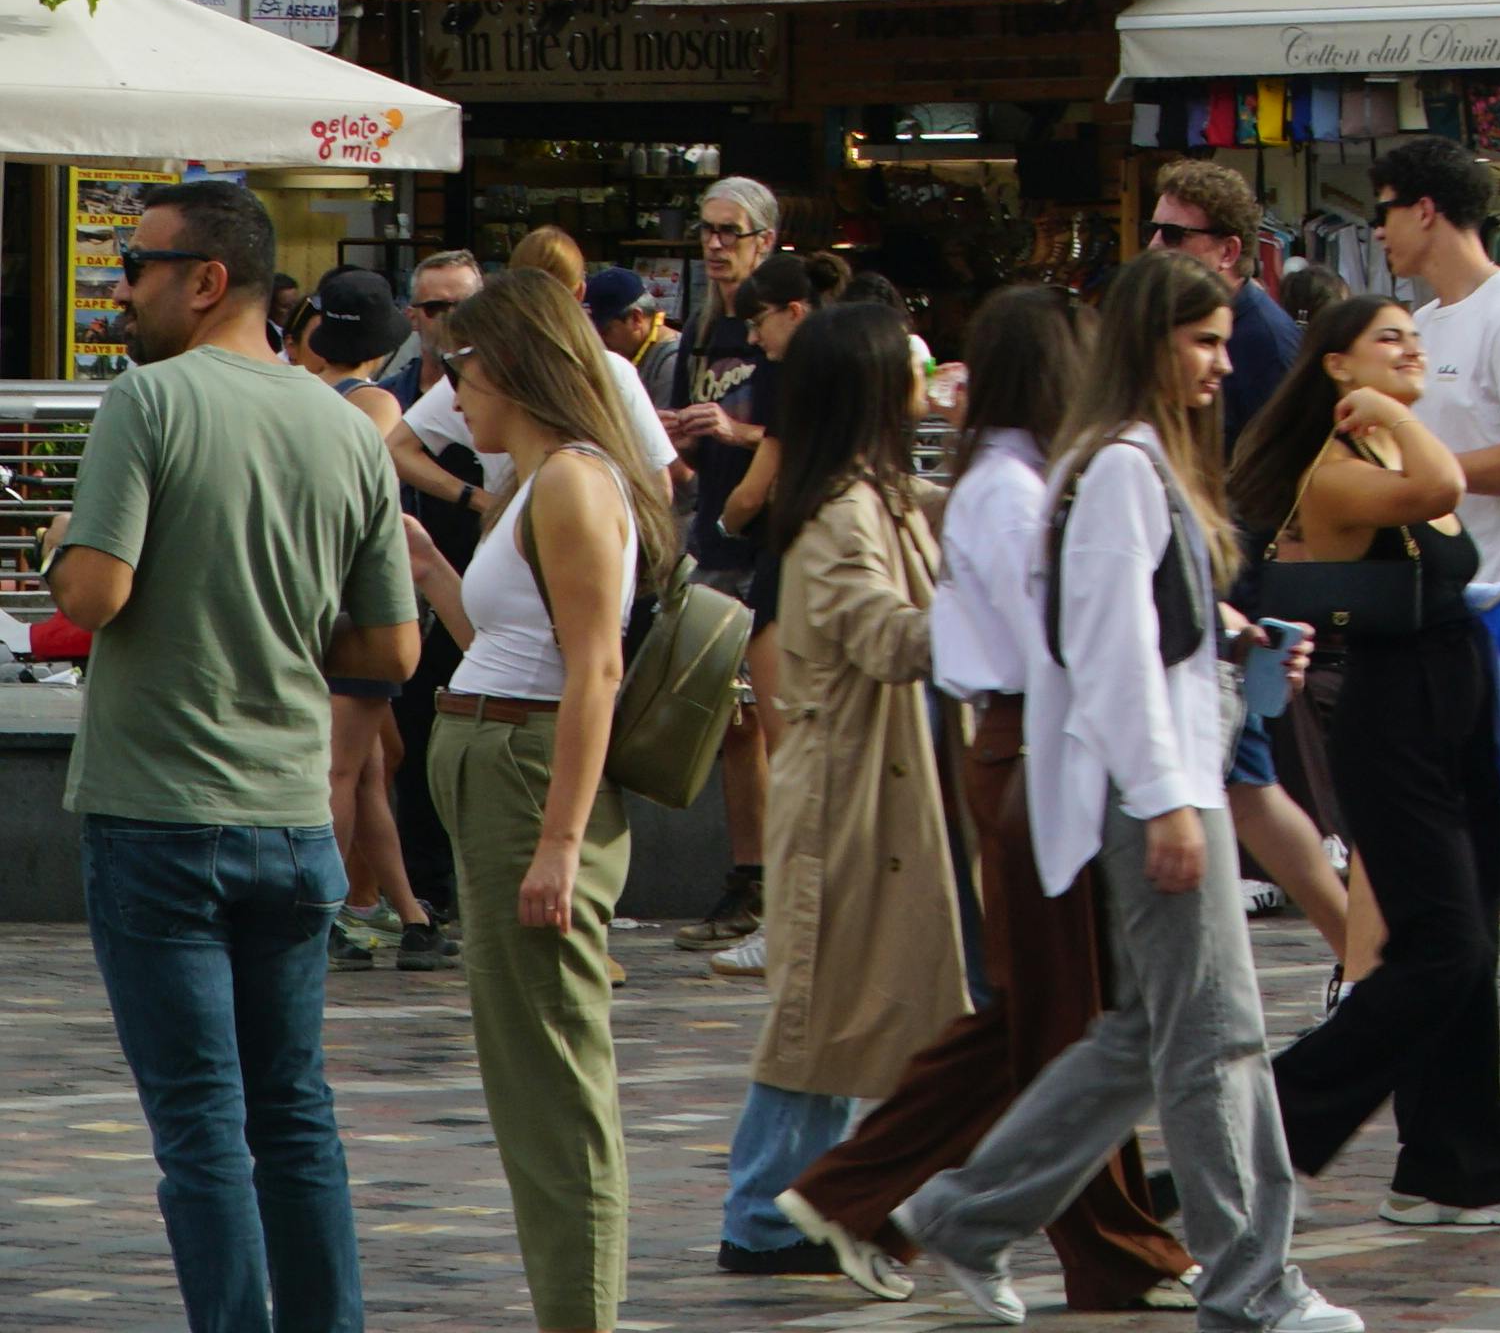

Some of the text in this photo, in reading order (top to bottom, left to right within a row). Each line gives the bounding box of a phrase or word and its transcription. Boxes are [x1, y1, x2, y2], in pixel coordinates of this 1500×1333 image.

[285, 4, 335, 18] AEGEAN
[459, 21, 766, 80] in the old mosque
[1280, 26, 1358, 67] Cotton
[1367, 34, 1412, 64] club
[311, 114, 378, 160] gelato
[343, 141, 381, 163] mio
[89, 215, 114, 225] DAY
[121, 216, 141, 225] DE
[87, 256, 115, 265] DAY
[75, 299, 106, 309] CAPE
[84, 345, 114, 354] DAYS
